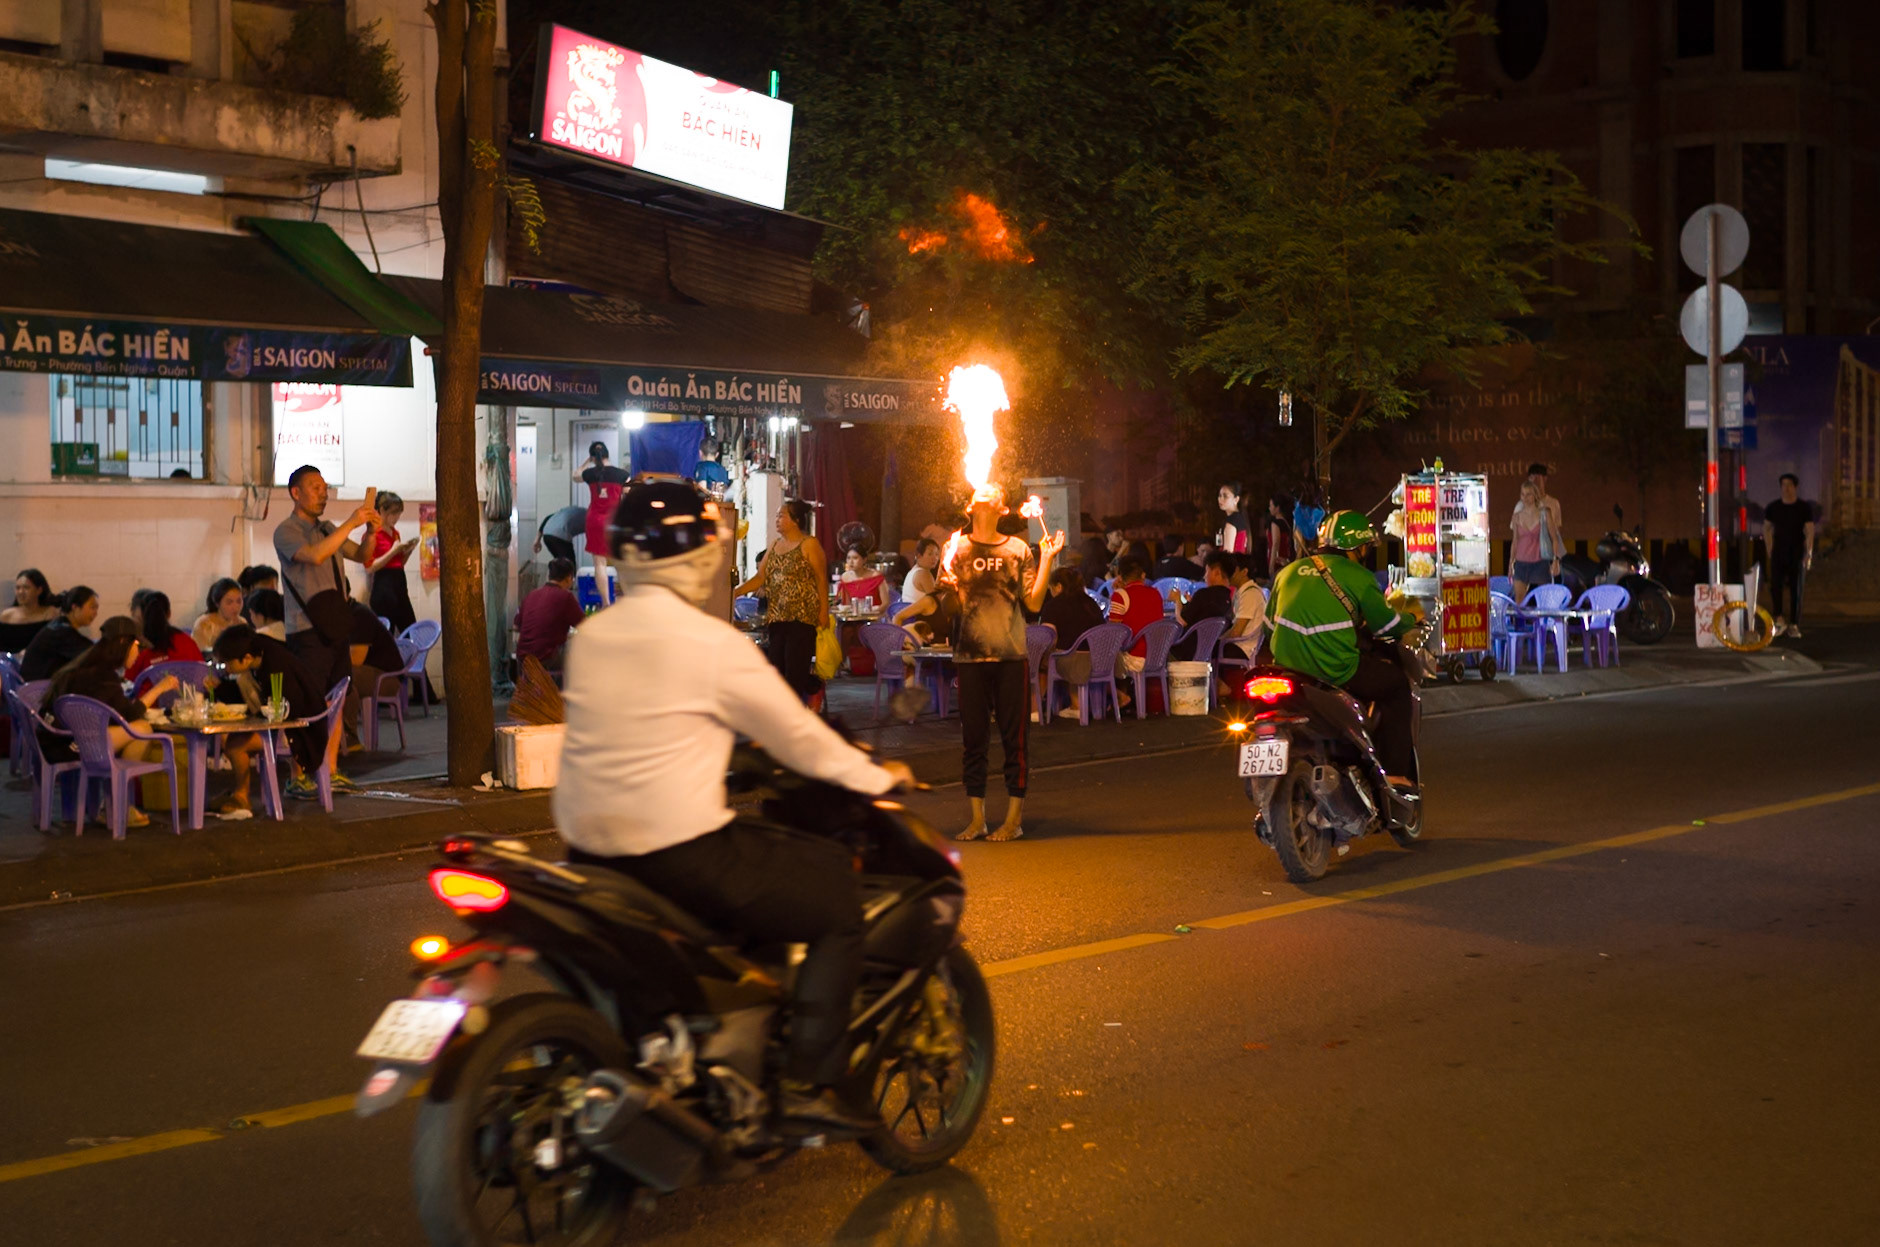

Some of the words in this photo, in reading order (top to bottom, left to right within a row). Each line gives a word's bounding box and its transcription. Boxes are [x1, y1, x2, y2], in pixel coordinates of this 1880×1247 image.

[552, 118, 623, 157] SAIGON
[12, 320, 52, 353] Ăn
[58, 325, 116, 357] BÁC
[123, 328, 189, 361] HIỀN
[264, 347, 335, 369] SAIGON
[191, 366, 196, 376] 1
[490, 371, 551, 392] SAIGON
[554, 382, 600, 395] SPECIAL
[627, 375, 681, 398] Quán
[685, 373, 711, 400] Ăn
[715, 377, 753, 402] BÁC
[757, 378, 801, 404] HIỀN
[851, 393, 899, 410] SAIGON
[1500, 384, 1520, 406] in
[1448, 421, 1500, 443] here,
[1507, 424, 1568, 446] every
[1408, 534, 1415, 545] A
[1417, 533, 1435, 546] BEO
[973, 557, 1003, 572] OFF
[1463, 583, 1487, 608] TRỘN
[1448, 615, 1457, 629] A
[1460, 613, 1482, 628] BEO
[1247, 744, 1281, 759] 50-N2
[1243, 758, 1283, 775] 267.49
